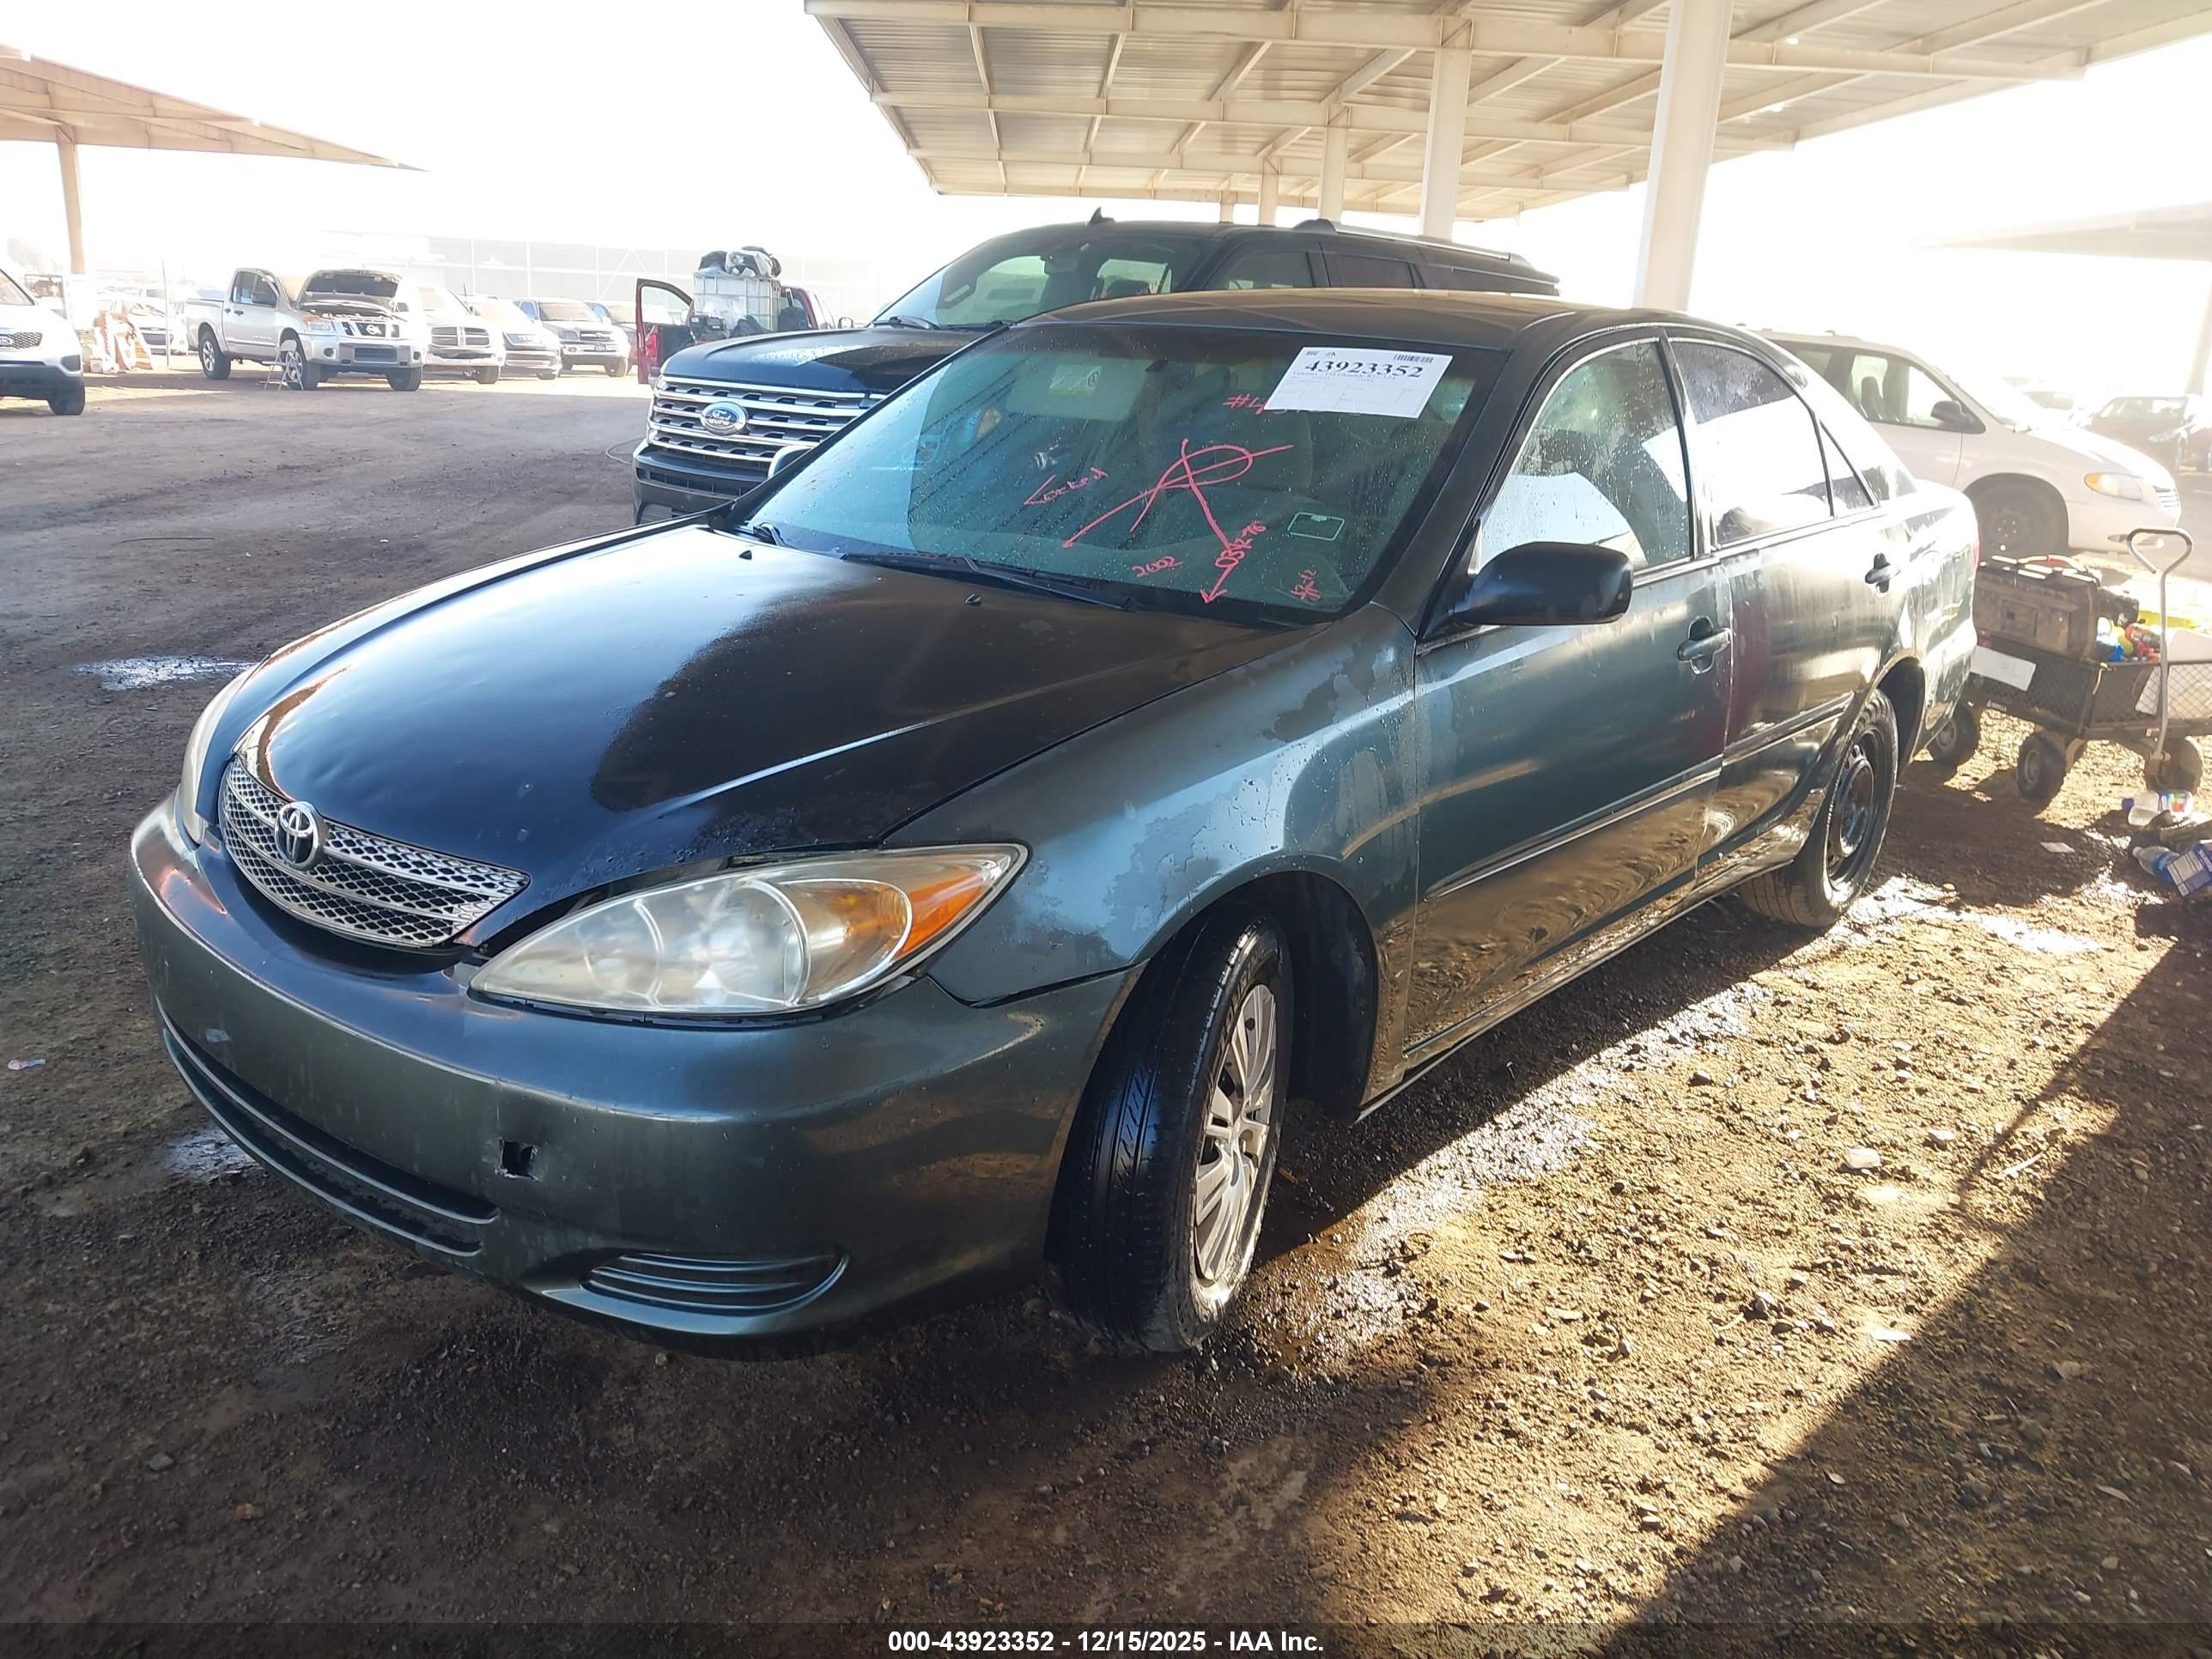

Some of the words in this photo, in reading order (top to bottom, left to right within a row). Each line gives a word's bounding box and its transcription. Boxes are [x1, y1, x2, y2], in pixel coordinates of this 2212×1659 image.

[1304, 359, 1424, 379] 43923352
[705, 410, 732, 426] Ford
[1131, 555, 1183, 578] 2002
